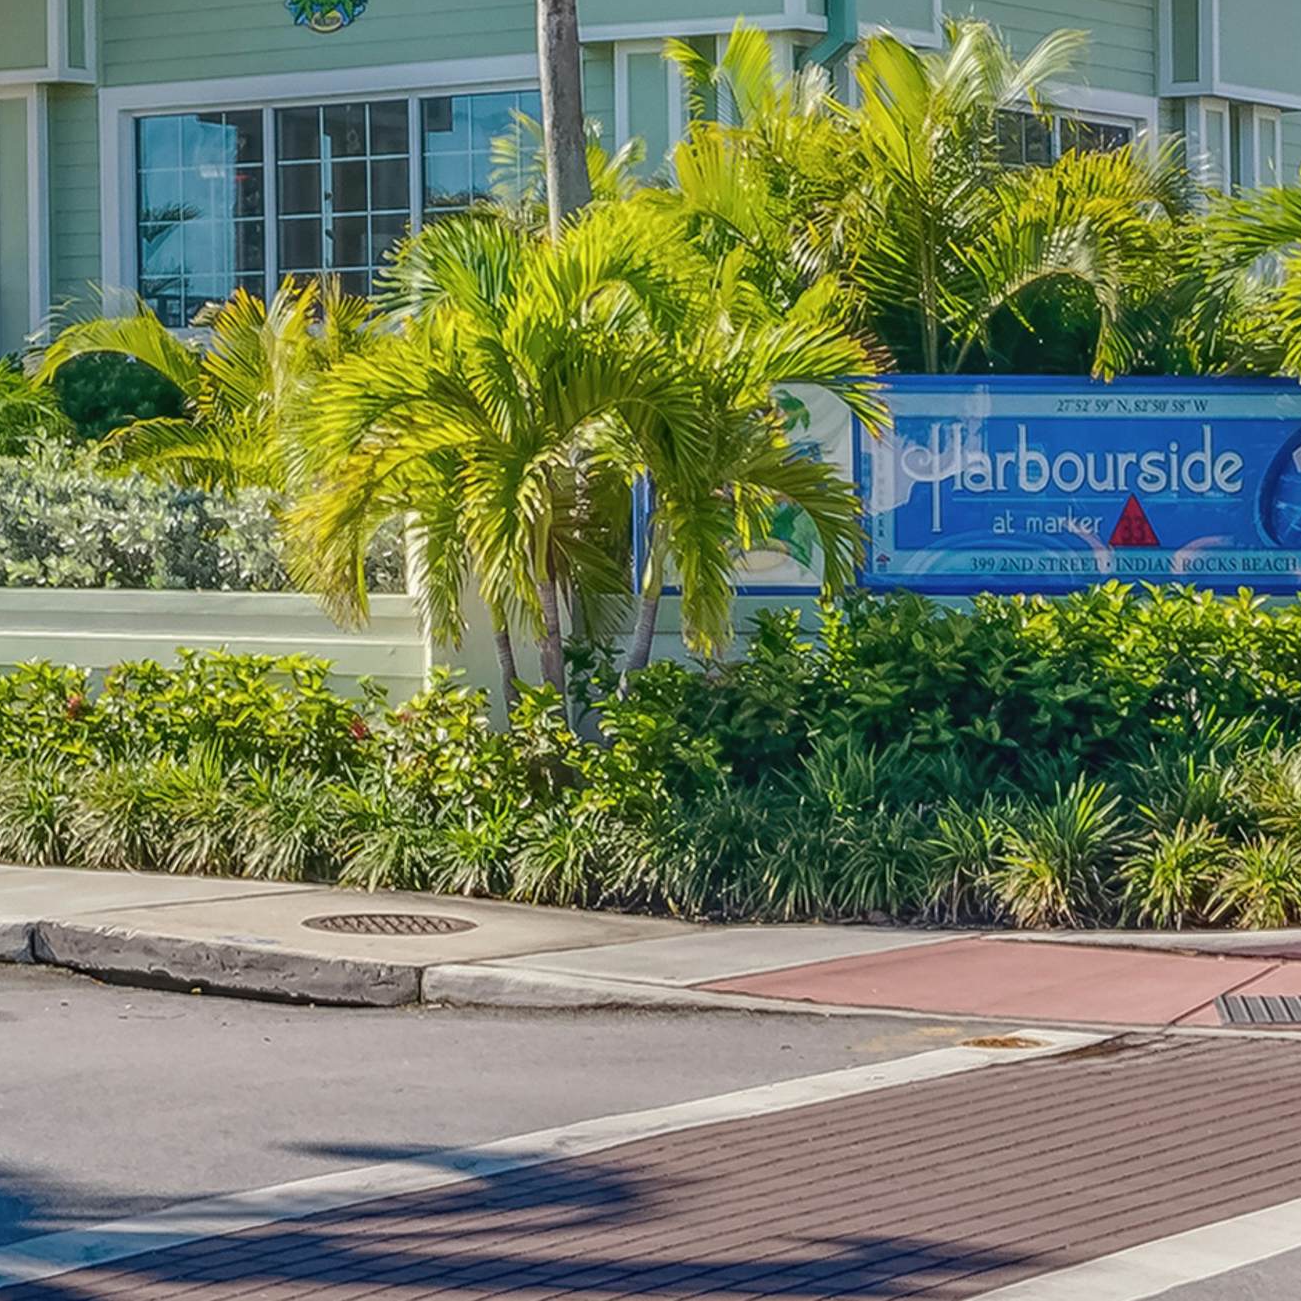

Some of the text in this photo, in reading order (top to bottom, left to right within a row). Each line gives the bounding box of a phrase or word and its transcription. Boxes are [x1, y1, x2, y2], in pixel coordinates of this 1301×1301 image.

[900, 422, 1245, 532] Harbourside
[993, 510, 1015, 534] at
[1025, 505, 1104, 534] marker
[970, 557, 1298, 572] 399 2ND STREET INDIAN ROCKS BEACH
